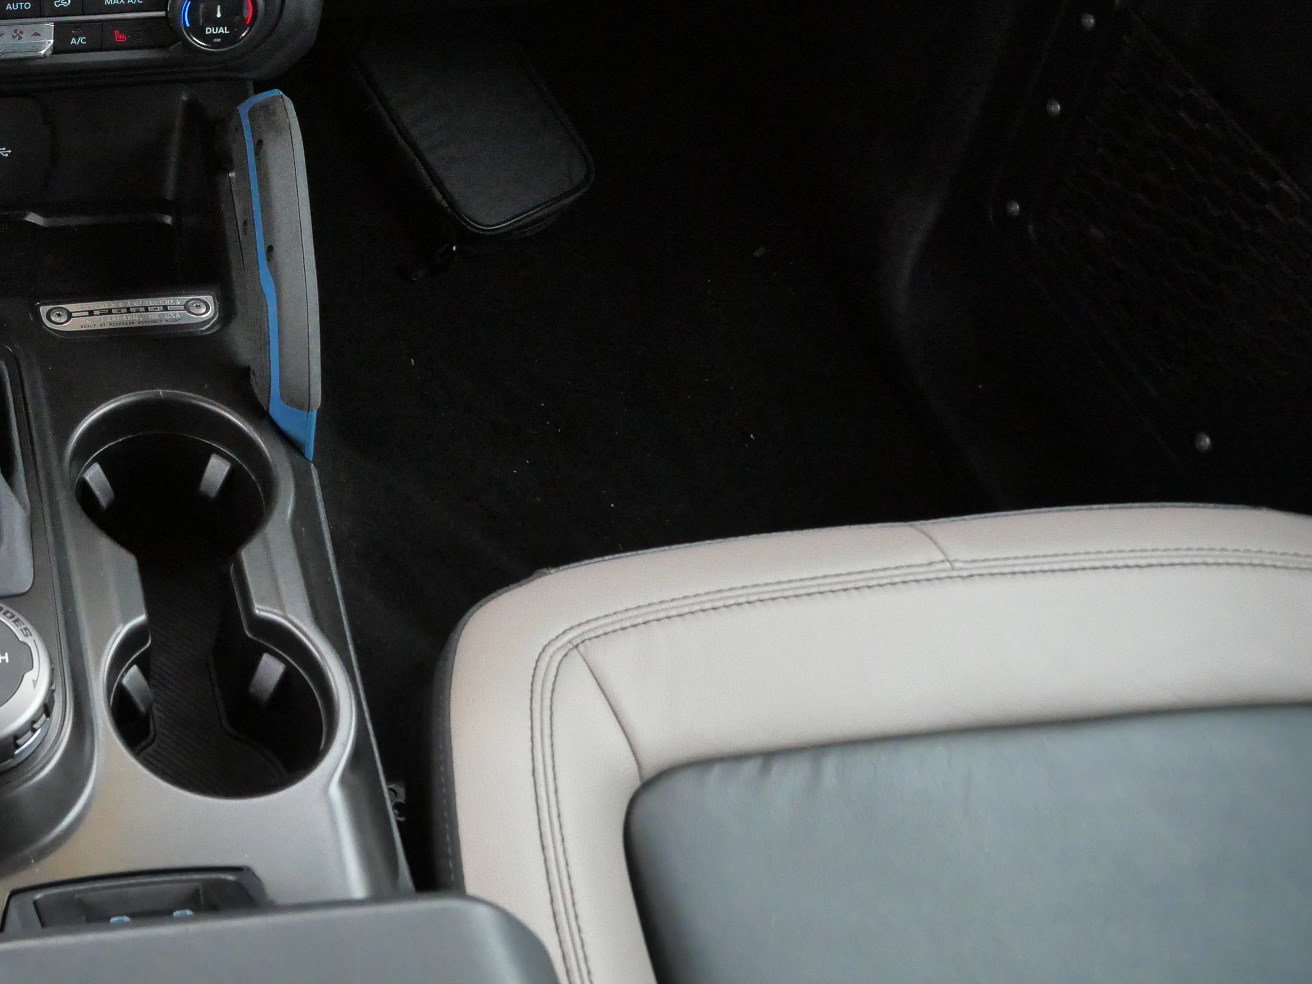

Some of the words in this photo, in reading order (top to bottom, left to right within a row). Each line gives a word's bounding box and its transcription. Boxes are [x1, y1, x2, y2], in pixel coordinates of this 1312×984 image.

[5, 1, 32, 11] AUTO
[205, 26, 230, 36] DUAL
[70, 36, 87, 46] A/C
